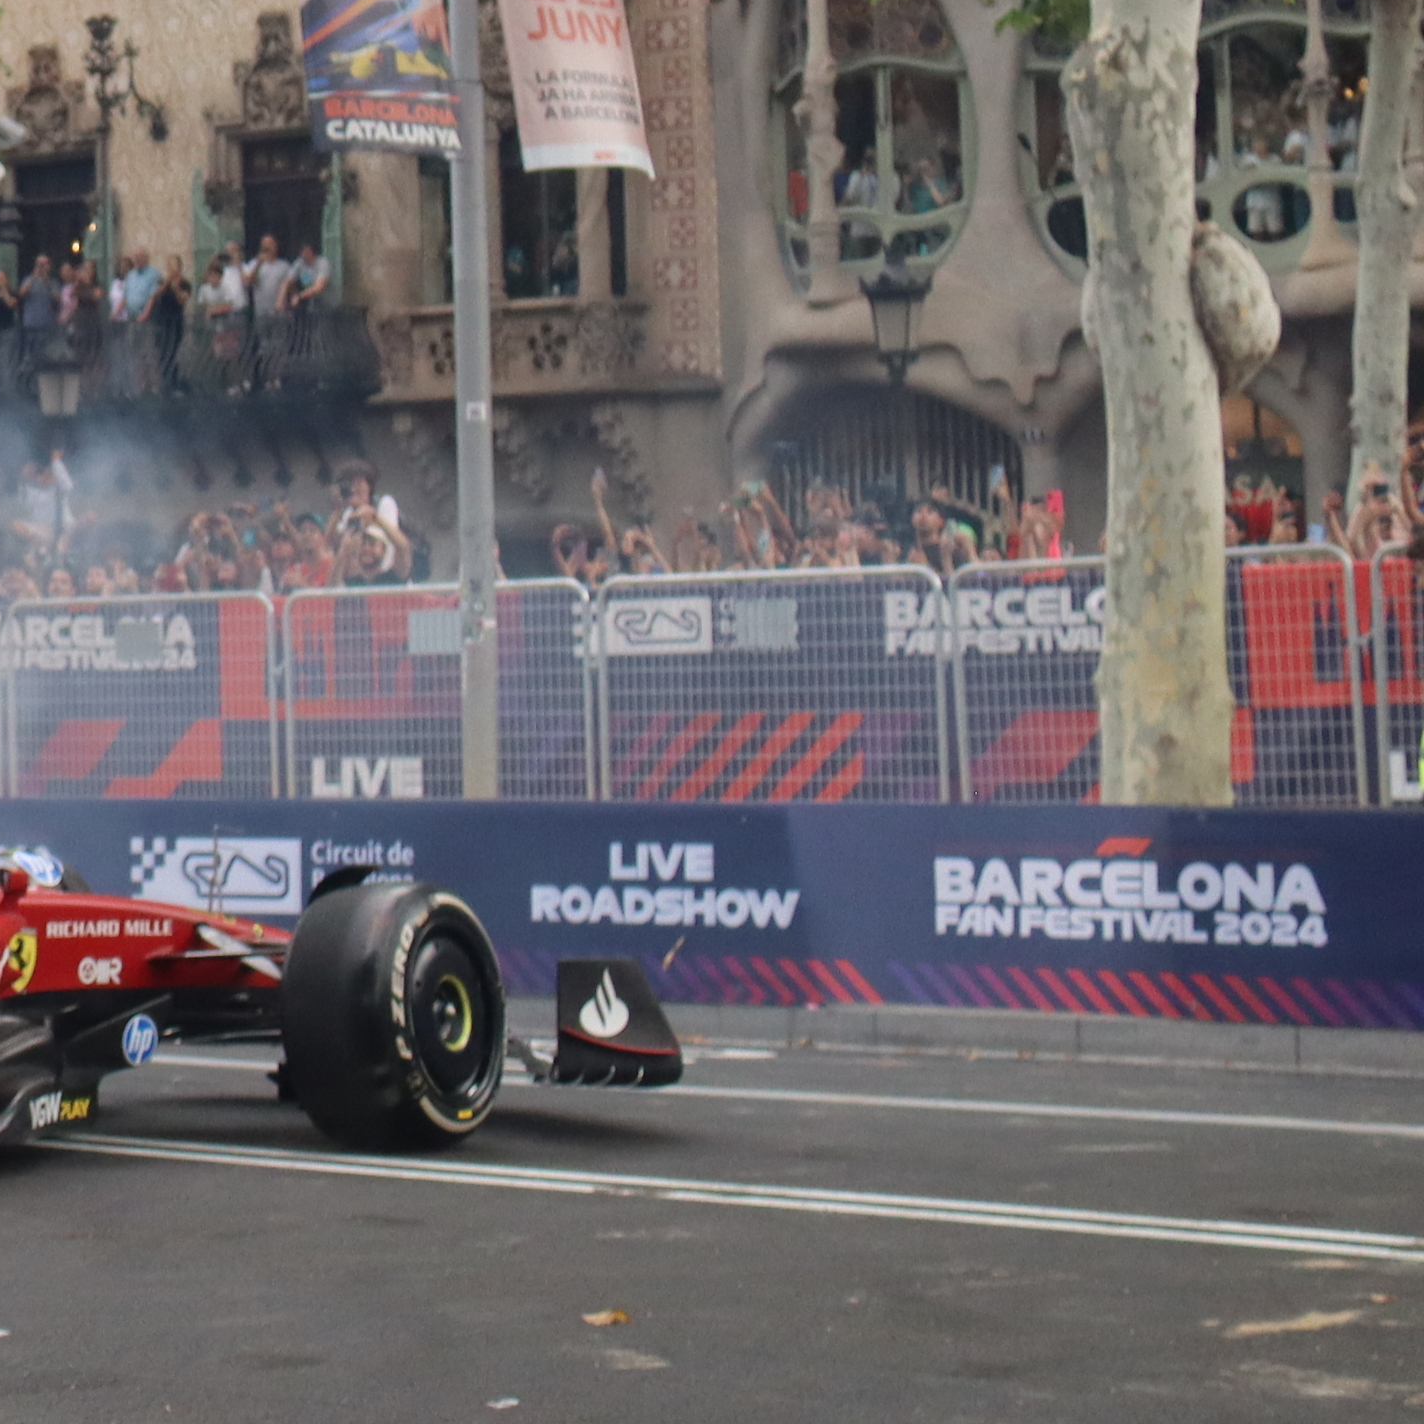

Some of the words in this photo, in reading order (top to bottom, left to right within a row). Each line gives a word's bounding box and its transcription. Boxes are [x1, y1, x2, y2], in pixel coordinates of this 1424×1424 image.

[528, 4, 624, 49] JUNY
[323, 97, 458, 128] BARCELONA
[325, 117, 462, 150] CATALUNYA
[310, 755, 425, 800] LIVE
[310, 838, 384, 866] Circuit
[387, 839, 415, 866] de
[609, 840, 715, 882] LIVE
[530, 883, 802, 930] ROADSHOW
[933, 855, 1328, 915] BARCELONA
[45, 920, 120, 939] RICHARD
[123, 918, 173, 937] MILLE
[934, 904, 1016, 938] FAN
[1019, 906, 1209, 944] FESTIVAL
[1213, 911, 1329, 949] 2024
